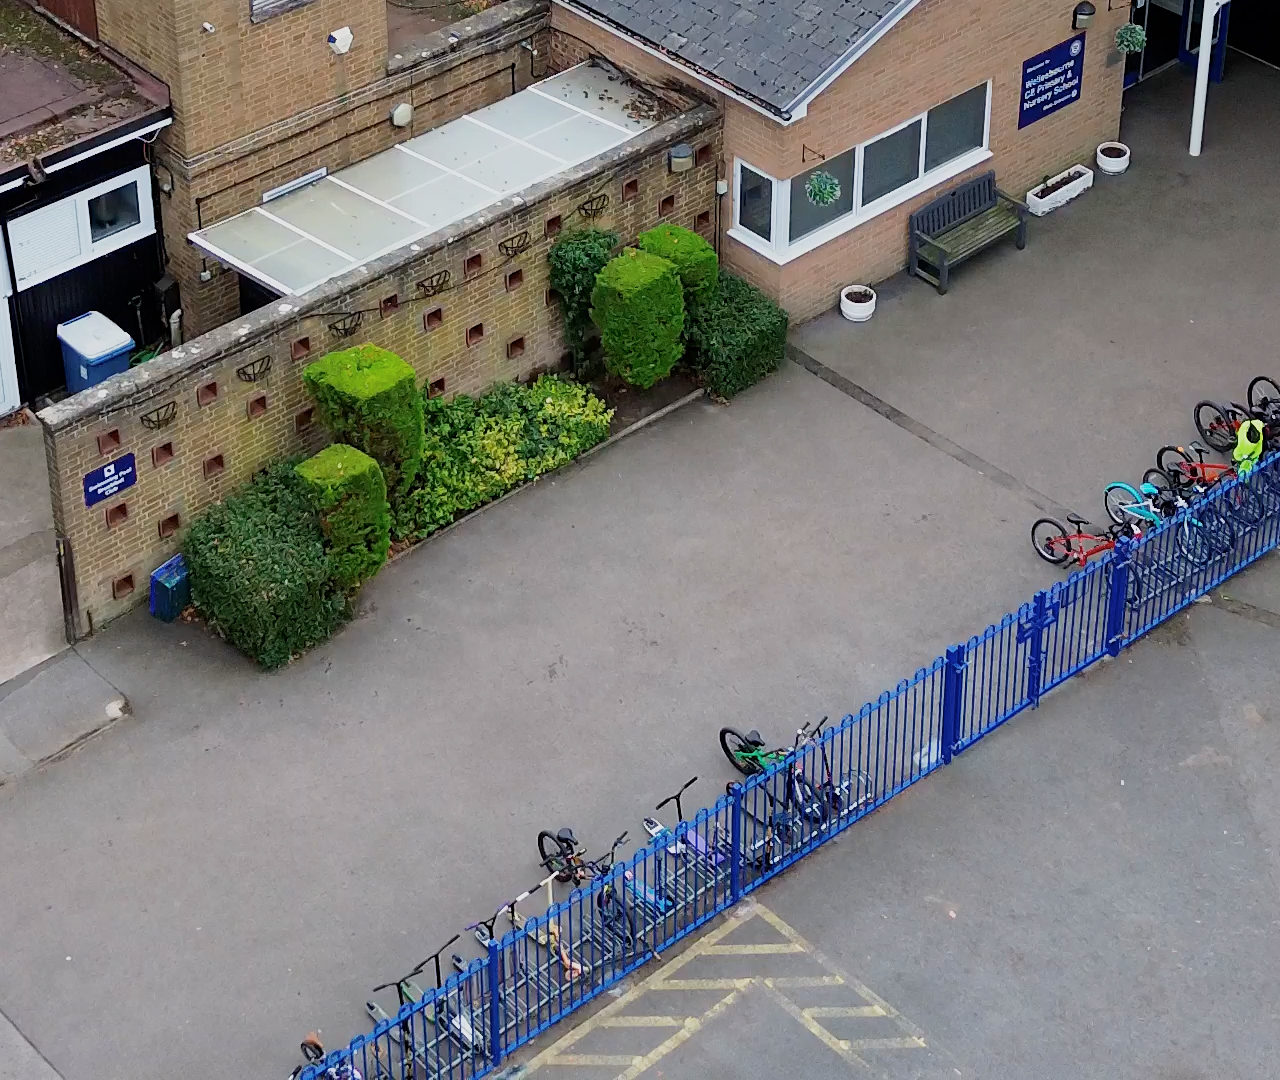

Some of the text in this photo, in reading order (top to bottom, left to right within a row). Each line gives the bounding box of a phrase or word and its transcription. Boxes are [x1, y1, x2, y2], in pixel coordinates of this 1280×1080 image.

[1023, 90, 1053, 111] Nursery
[1053, 75, 1079, 95] School
[1036, 74, 1066, 94] Primary
